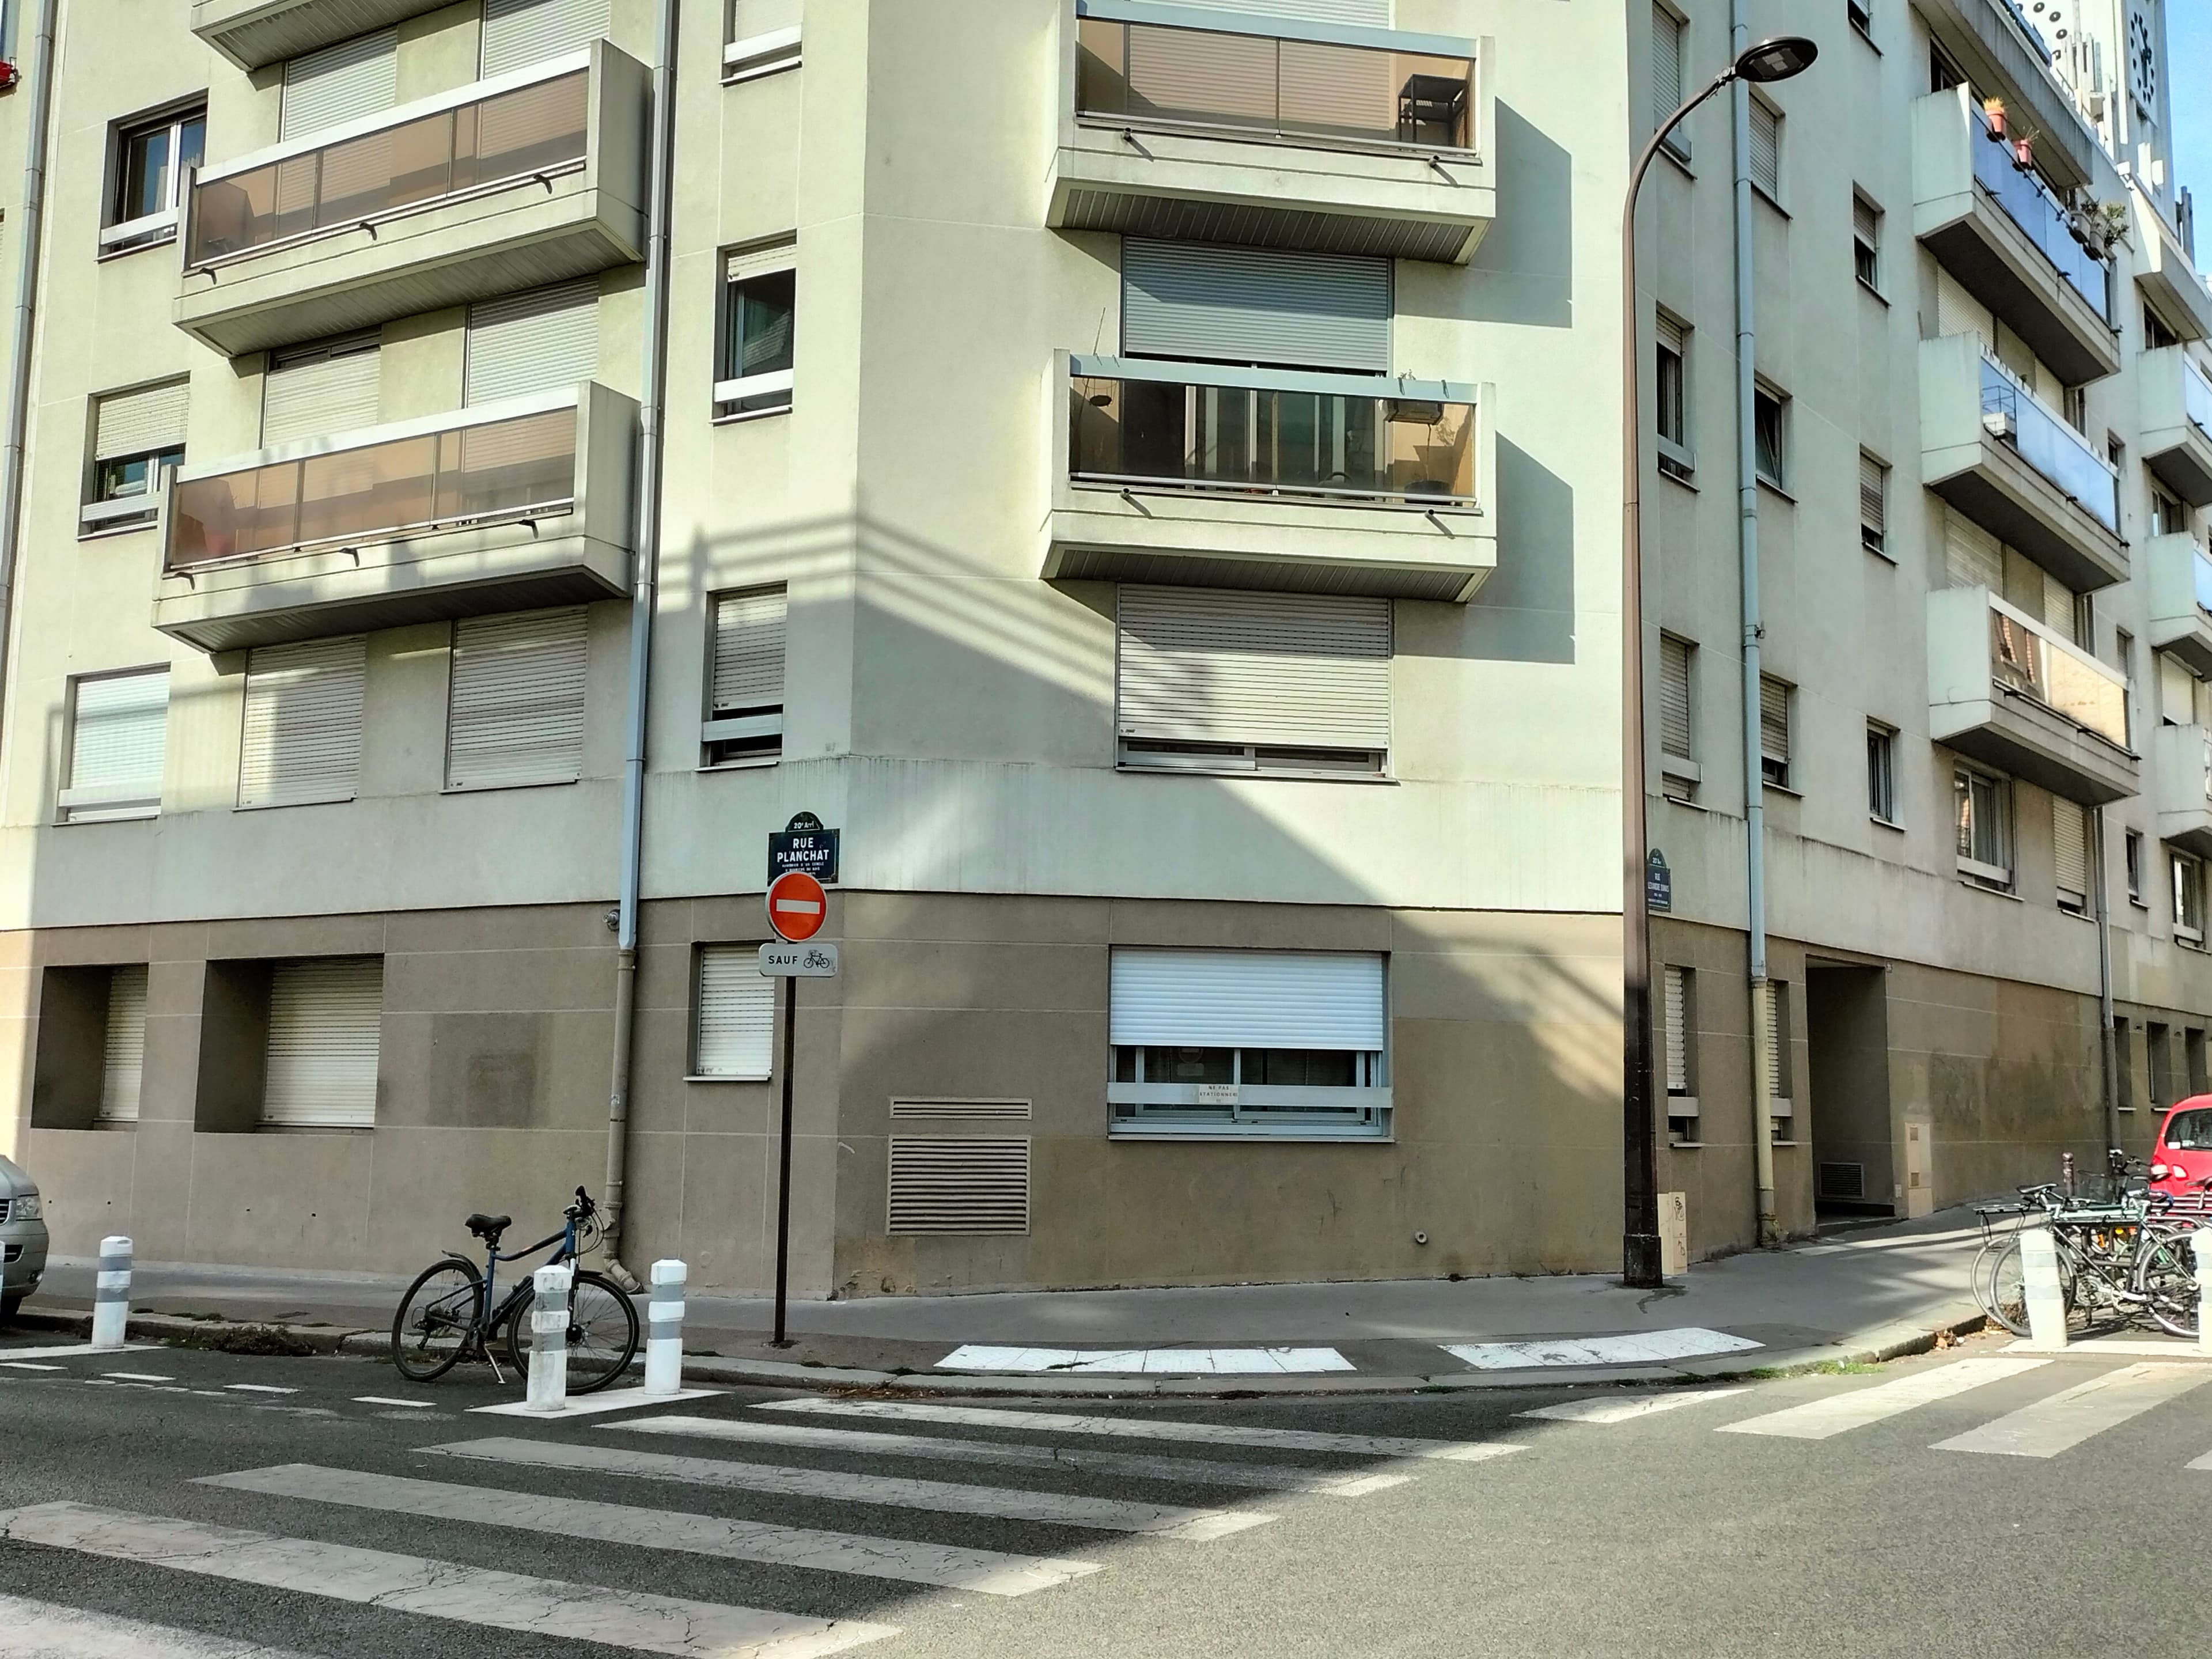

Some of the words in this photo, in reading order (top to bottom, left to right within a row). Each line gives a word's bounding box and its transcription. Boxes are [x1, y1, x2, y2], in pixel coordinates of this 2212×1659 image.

[793, 837, 814, 849] RUE
[777, 849, 830, 863] PLANCHAT
[768, 955, 798, 964] SAUF
